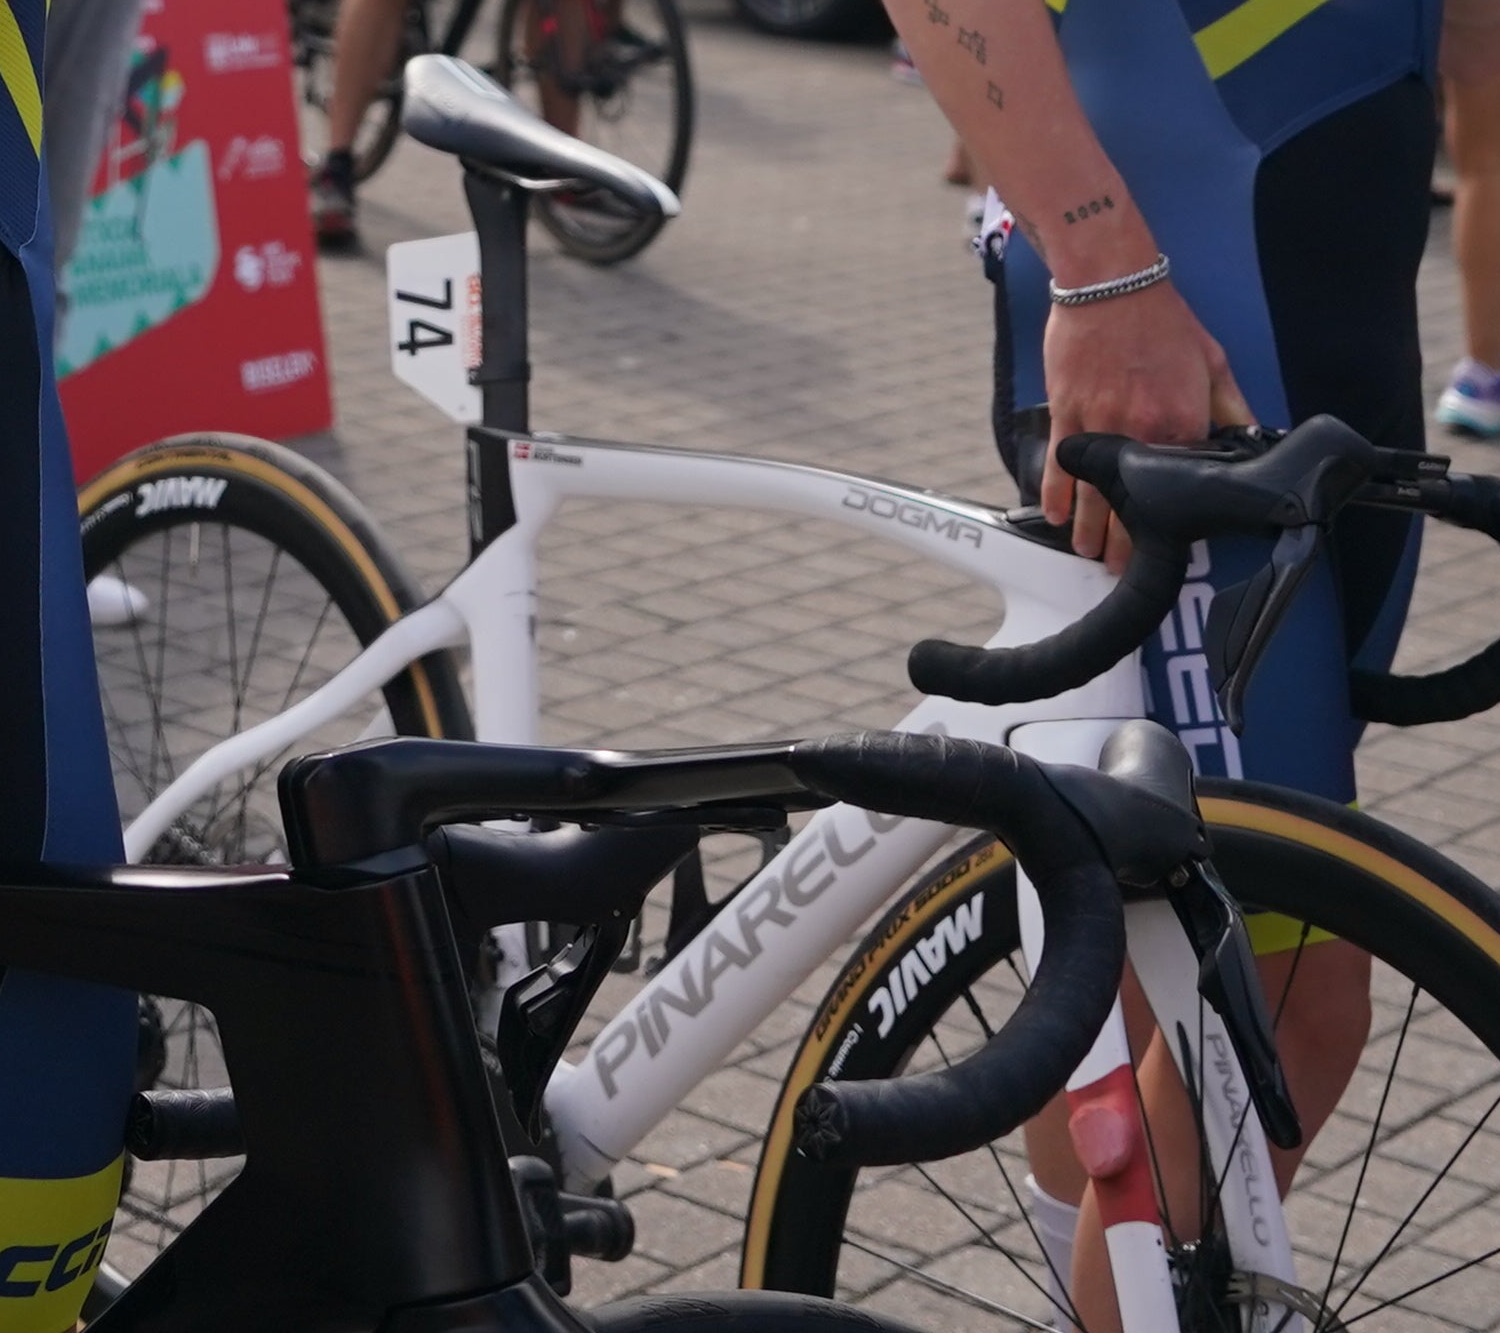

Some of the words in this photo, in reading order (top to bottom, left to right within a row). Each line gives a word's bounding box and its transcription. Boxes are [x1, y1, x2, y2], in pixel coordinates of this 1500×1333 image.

[395, 277, 454, 356] 74
[842, 486, 984, 549] DOGMA
[867, 890, 985, 1040] MAVIC
